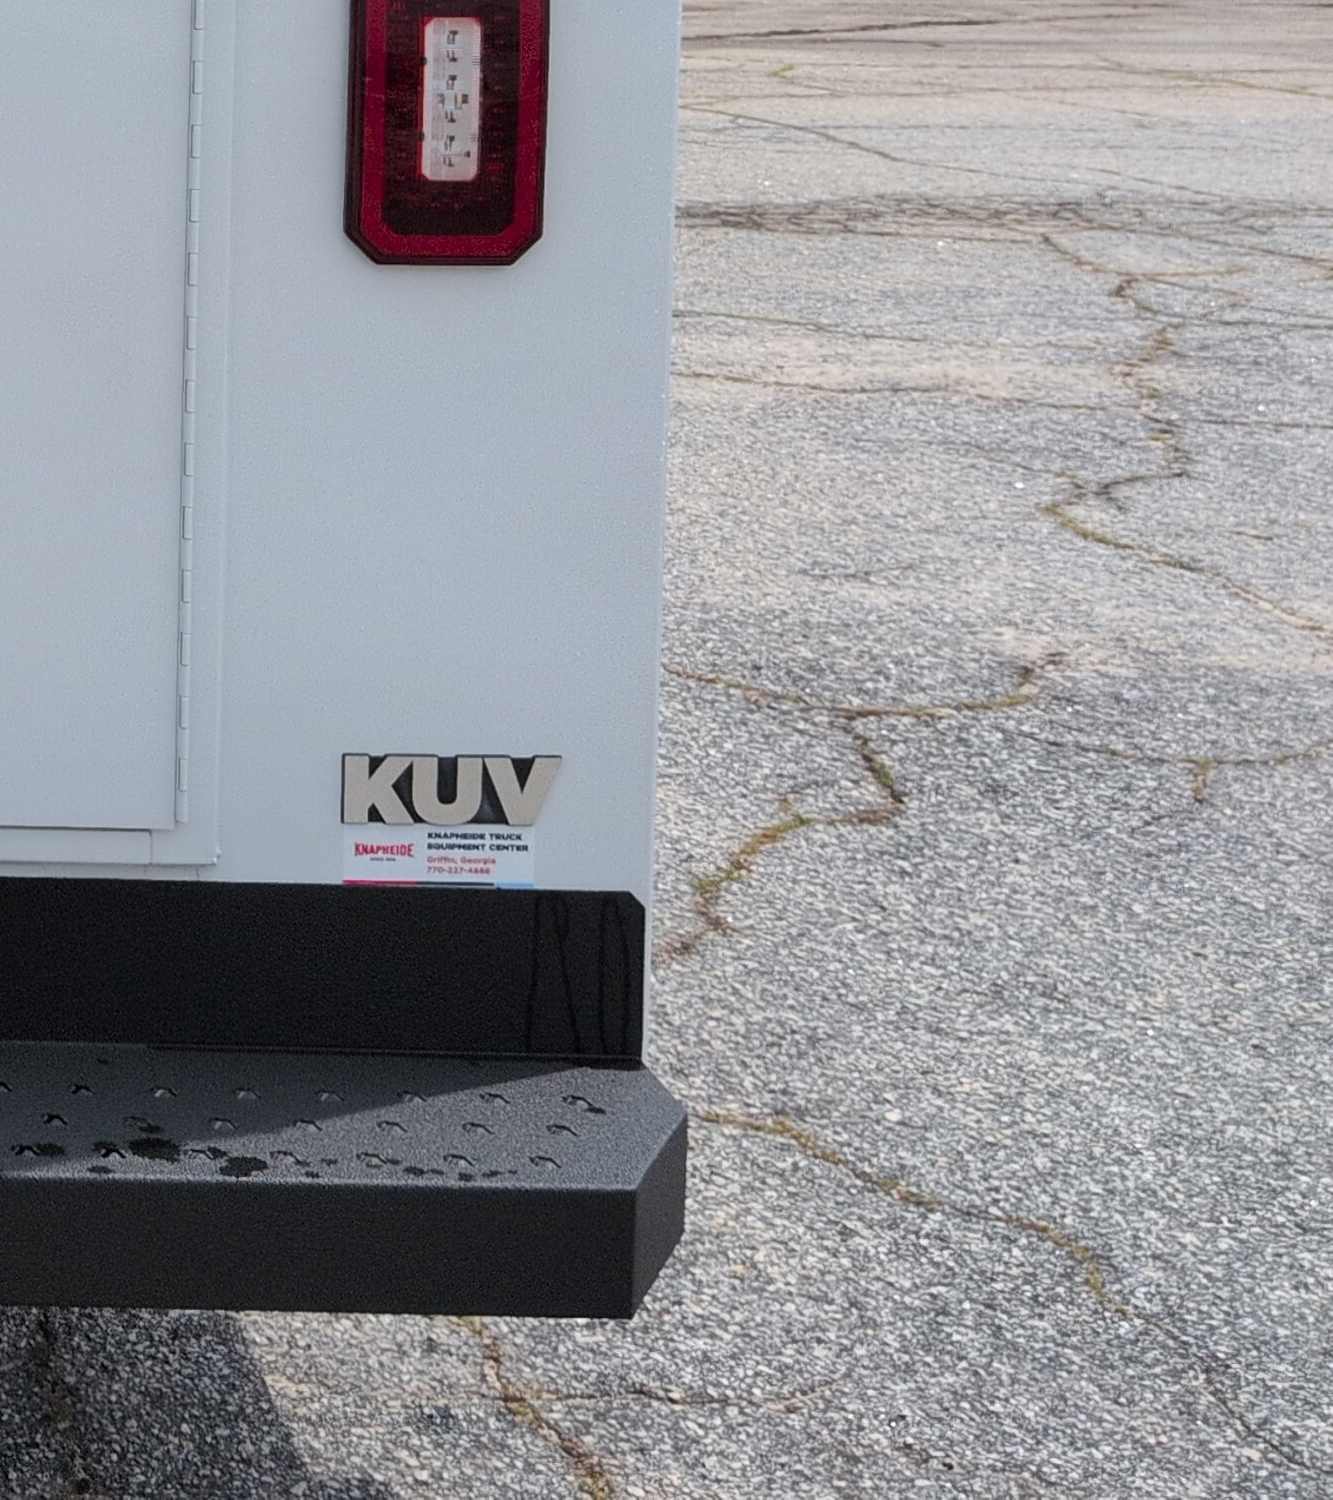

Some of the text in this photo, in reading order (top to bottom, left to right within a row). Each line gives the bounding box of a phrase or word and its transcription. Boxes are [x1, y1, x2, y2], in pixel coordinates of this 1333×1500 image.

[340, 753, 562, 826] KUV
[427, 832, 523, 842] KNAPHEIDE TRUCK
[354, 842, 414, 857] KNAPHEIDE
[427, 843, 529, 852] EQUIPMENT CENTER
[460, 856, 496, 865] Georgia
